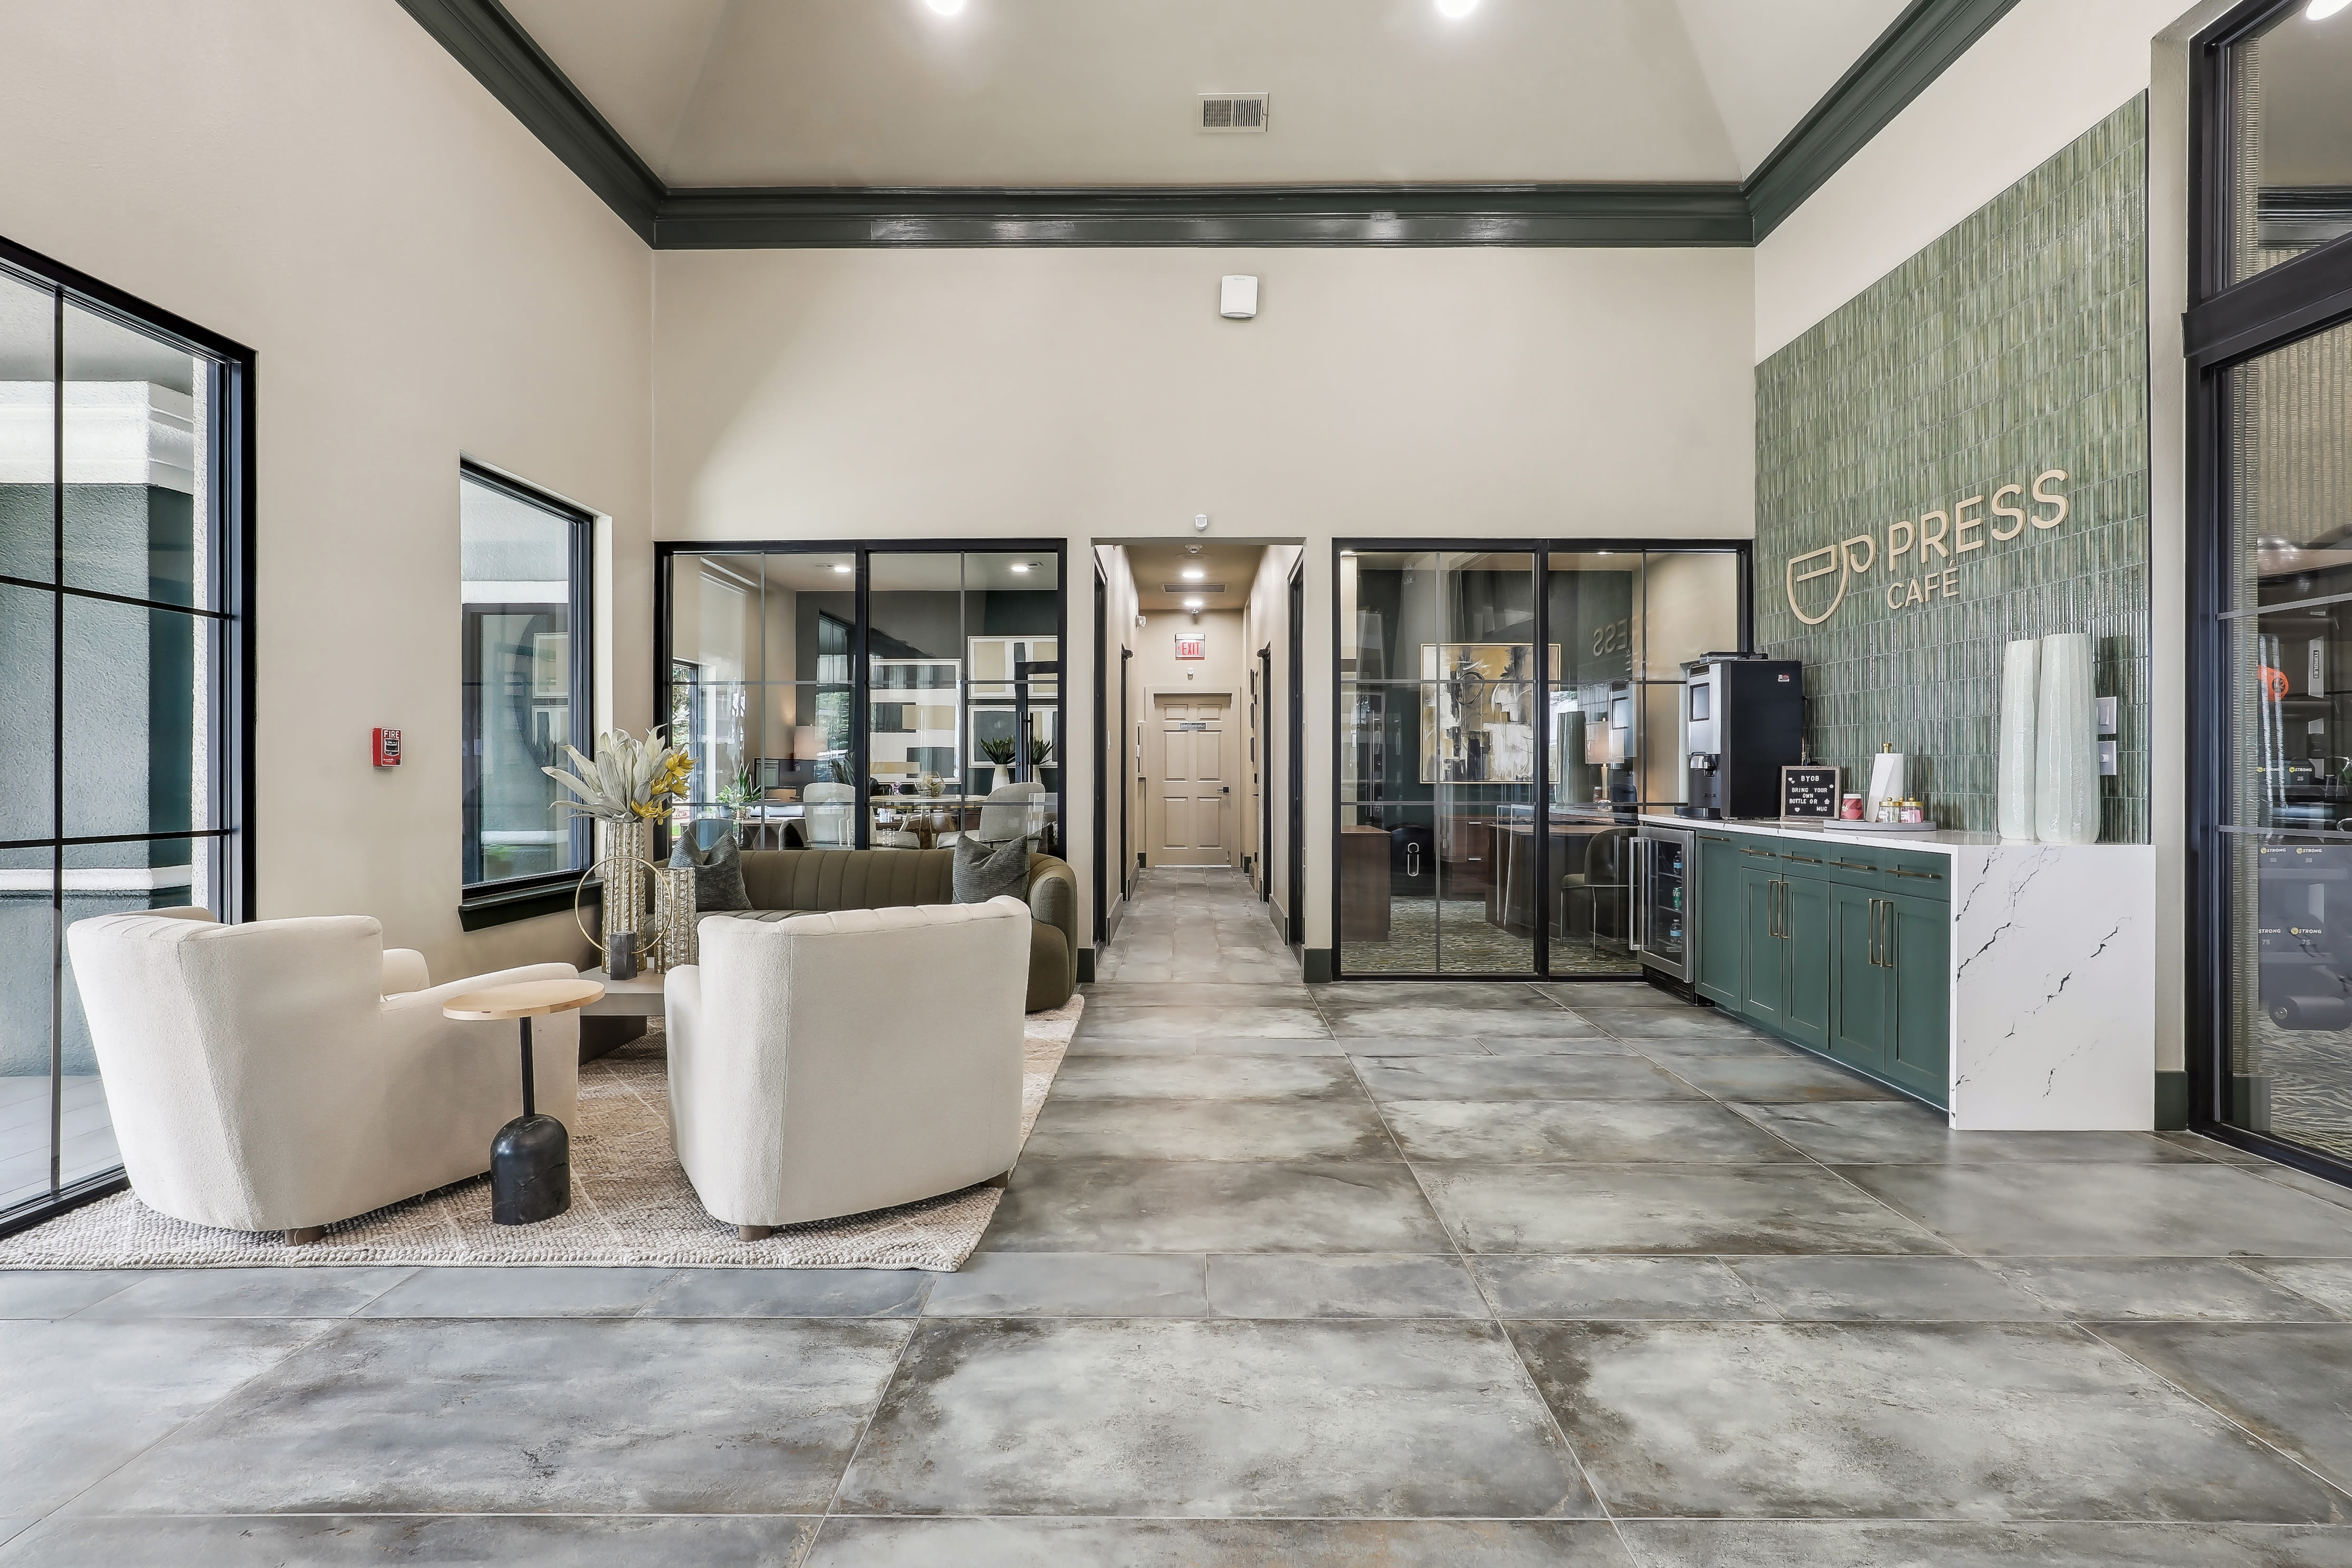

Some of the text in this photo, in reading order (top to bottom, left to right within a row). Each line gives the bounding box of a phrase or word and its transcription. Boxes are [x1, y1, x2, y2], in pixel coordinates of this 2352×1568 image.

[1888, 468, 2070, 572] PRESS
[1887, 560, 1960, 610] CAFÉ
[1182, 642, 1201, 655] EXIT
[384, 730, 399, 739] FIRE
